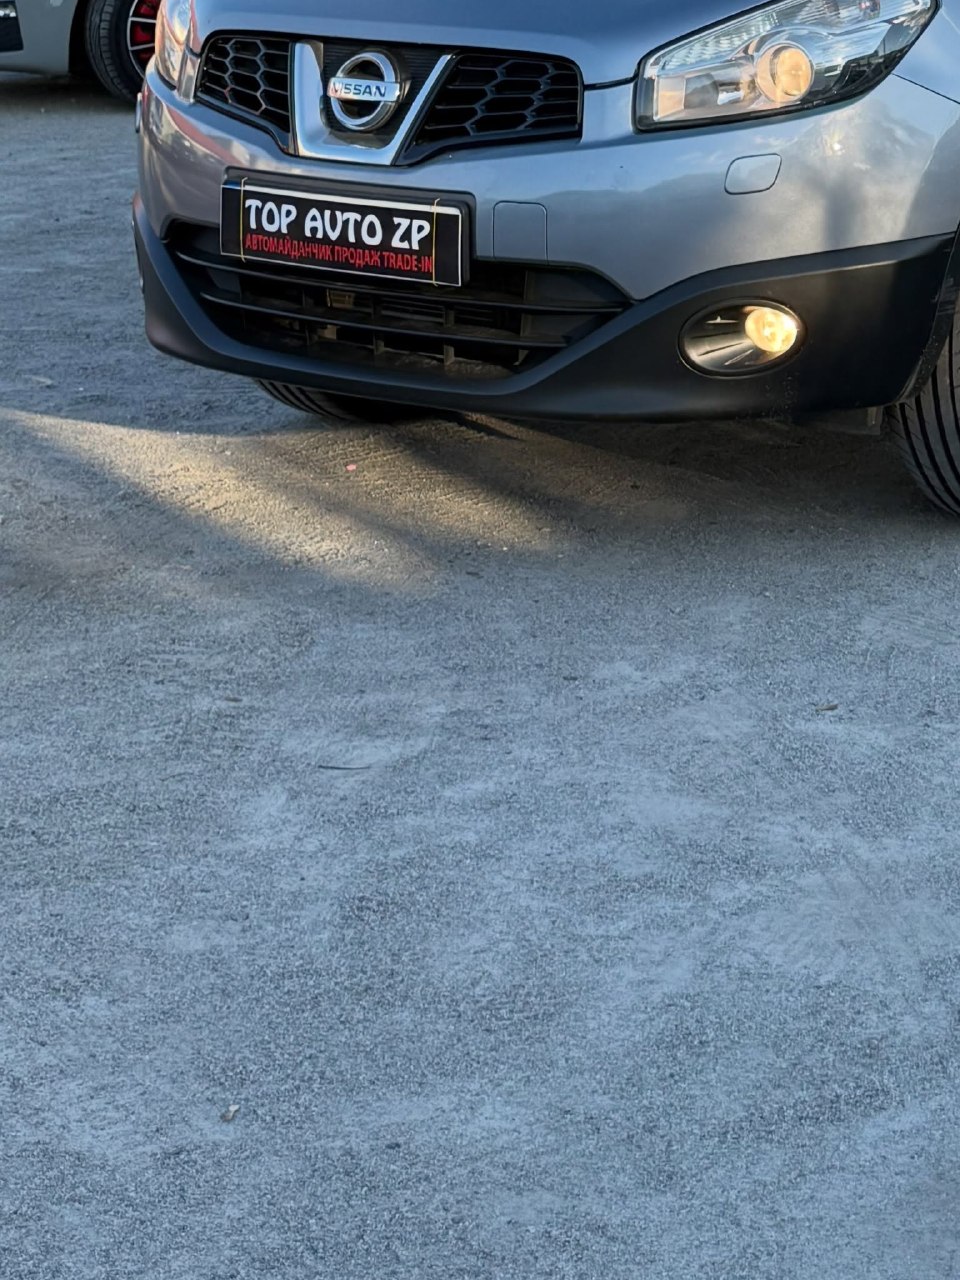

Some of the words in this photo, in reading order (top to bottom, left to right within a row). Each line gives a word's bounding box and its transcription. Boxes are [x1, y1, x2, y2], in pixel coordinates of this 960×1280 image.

[331, 81, 387, 98] NISSAN
[245, 199, 297, 234] TOP
[391, 216, 430, 250] ZP
[245, 233, 333, 260] АВТОМАЙДАНЧИК
[334, 245, 381, 269] ПРОДАЖ
[382, 251, 433, 273] TRADE-IN
